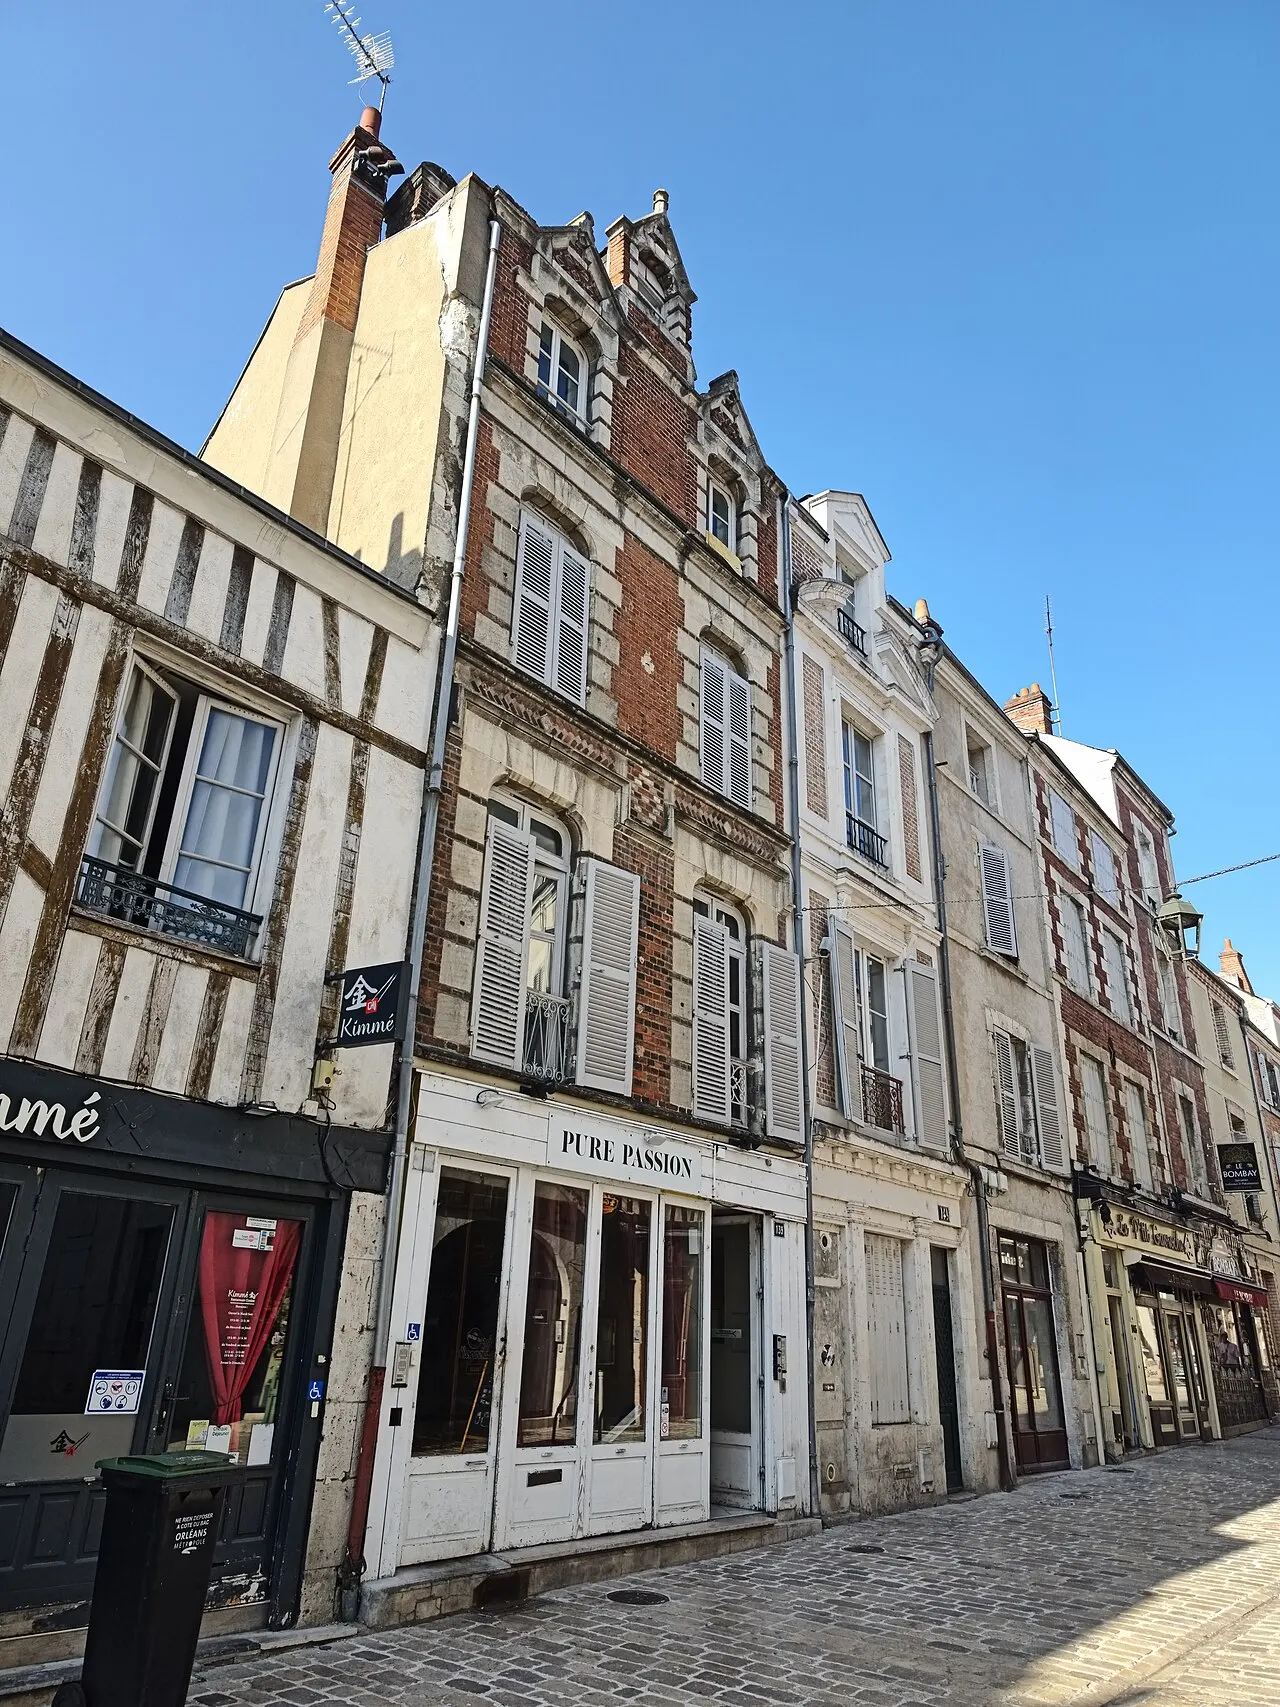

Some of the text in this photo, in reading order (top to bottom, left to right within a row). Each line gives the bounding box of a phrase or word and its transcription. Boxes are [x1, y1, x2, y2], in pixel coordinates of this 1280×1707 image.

[340, 1012, 395, 1038] Kimmé
[561, 1130, 693, 1179] PURE PASSION
[1222, 1169, 1258, 1178] BOMBAY
[175, 1528, 207, 1541] ORLÉANS
